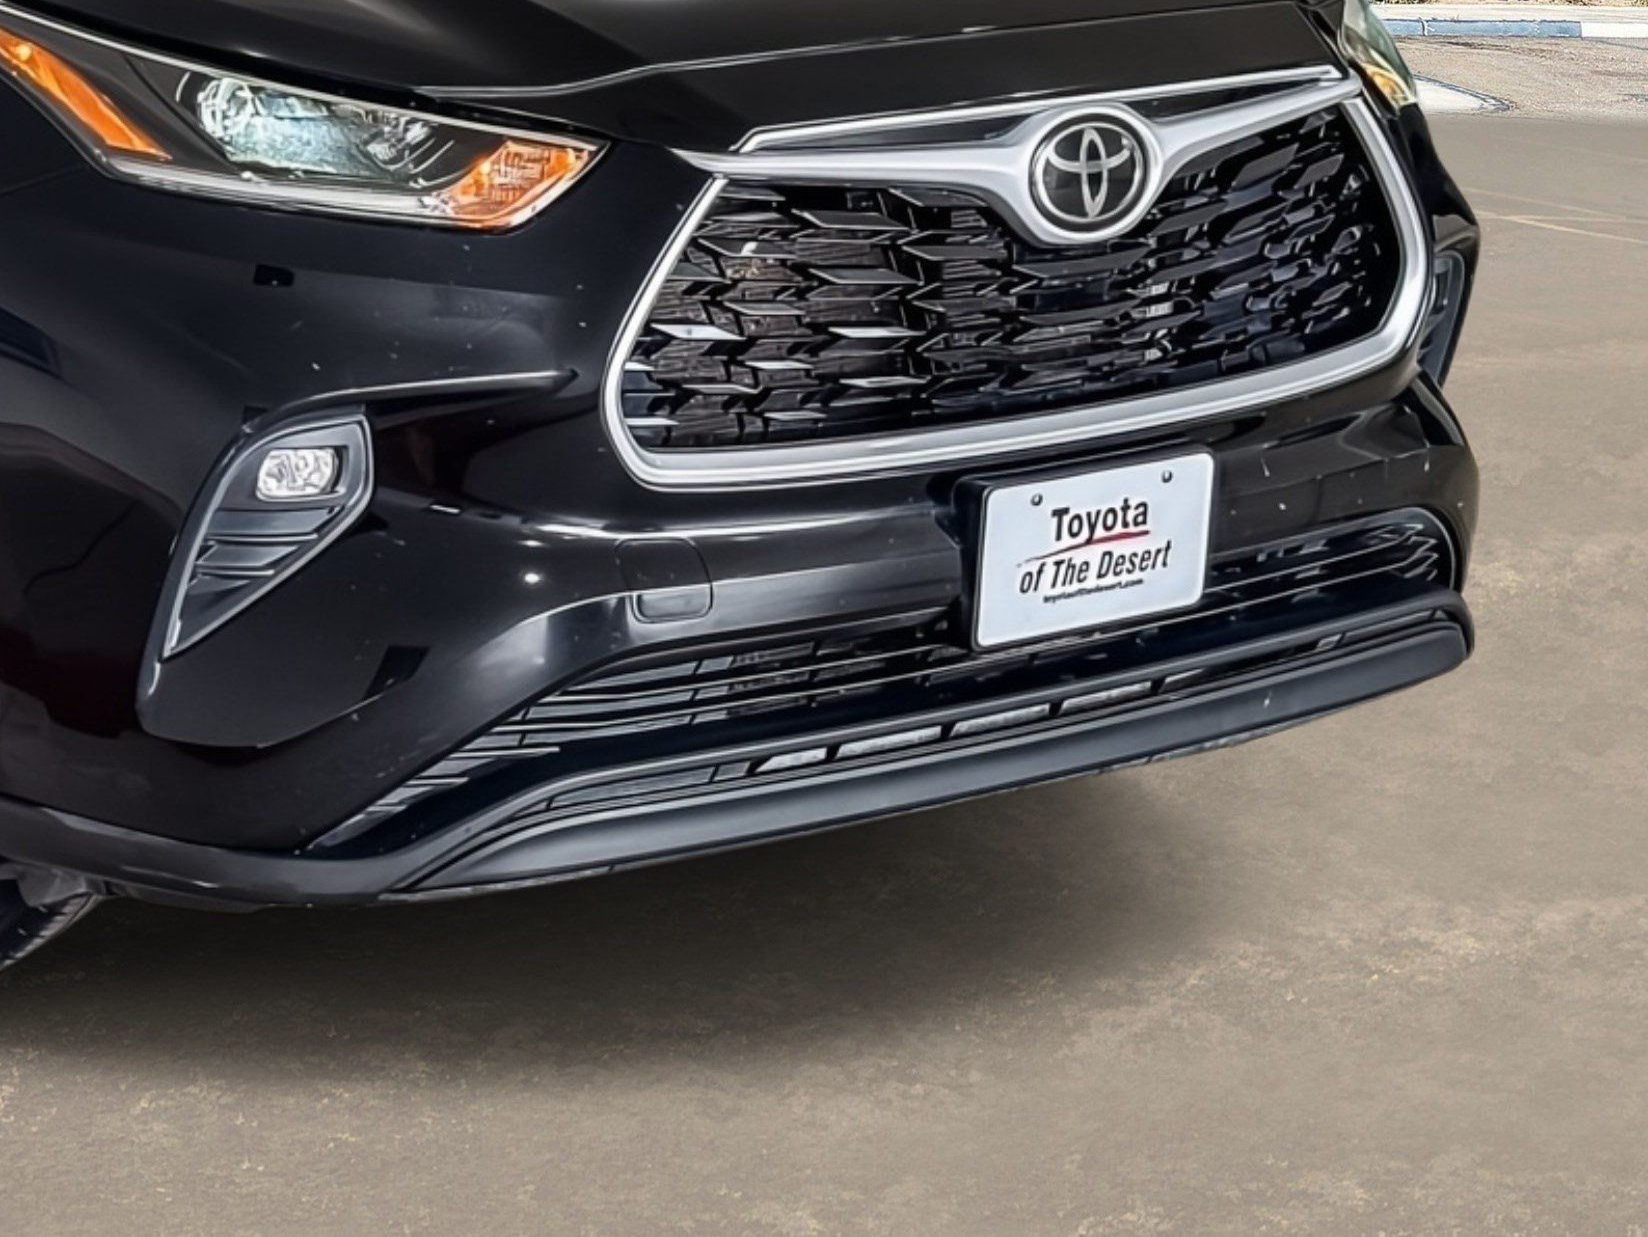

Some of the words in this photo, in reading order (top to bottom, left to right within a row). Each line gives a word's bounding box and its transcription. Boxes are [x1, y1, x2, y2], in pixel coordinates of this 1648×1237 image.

[1051, 497, 1149, 544] Toyota
[1019, 561, 1046, 594] of
[1051, 558, 1090, 589] The
[1096, 540, 1172, 580] Desert
